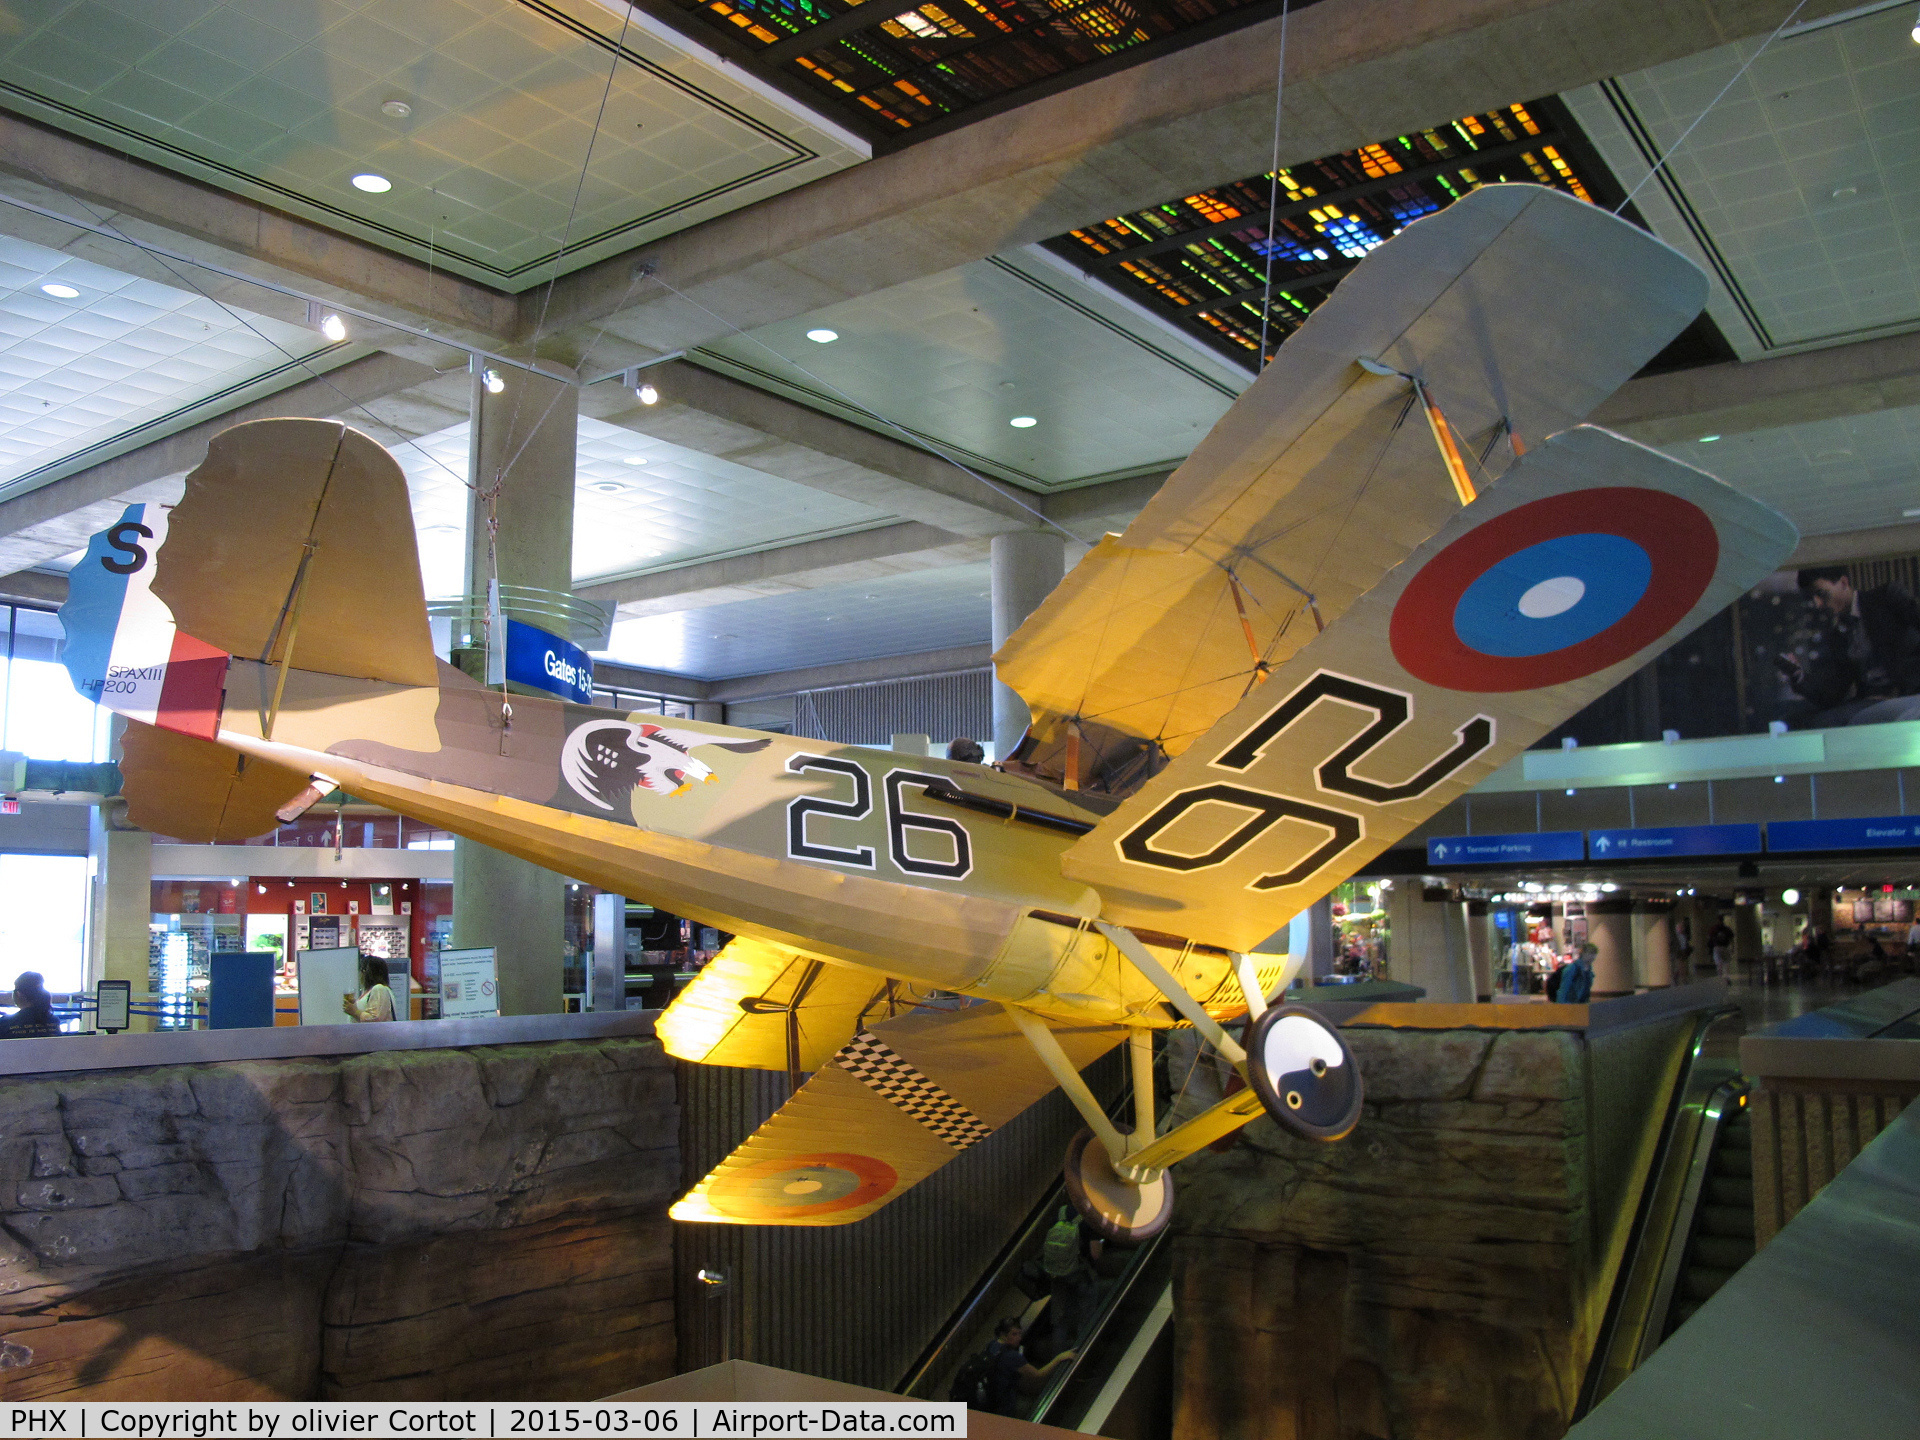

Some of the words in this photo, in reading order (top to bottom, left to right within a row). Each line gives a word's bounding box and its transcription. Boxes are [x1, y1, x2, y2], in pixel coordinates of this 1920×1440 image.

[101, 522, 154, 575] S
[108, 665, 163, 681] SPAXIII
[544, 650, 577, 686] Gates
[1114, 668, 1497, 893] 26
[785, 751, 974, 882] 26
[1467, 846, 1499, 854] Terminal
[1501, 844, 1531, 854] Parking
